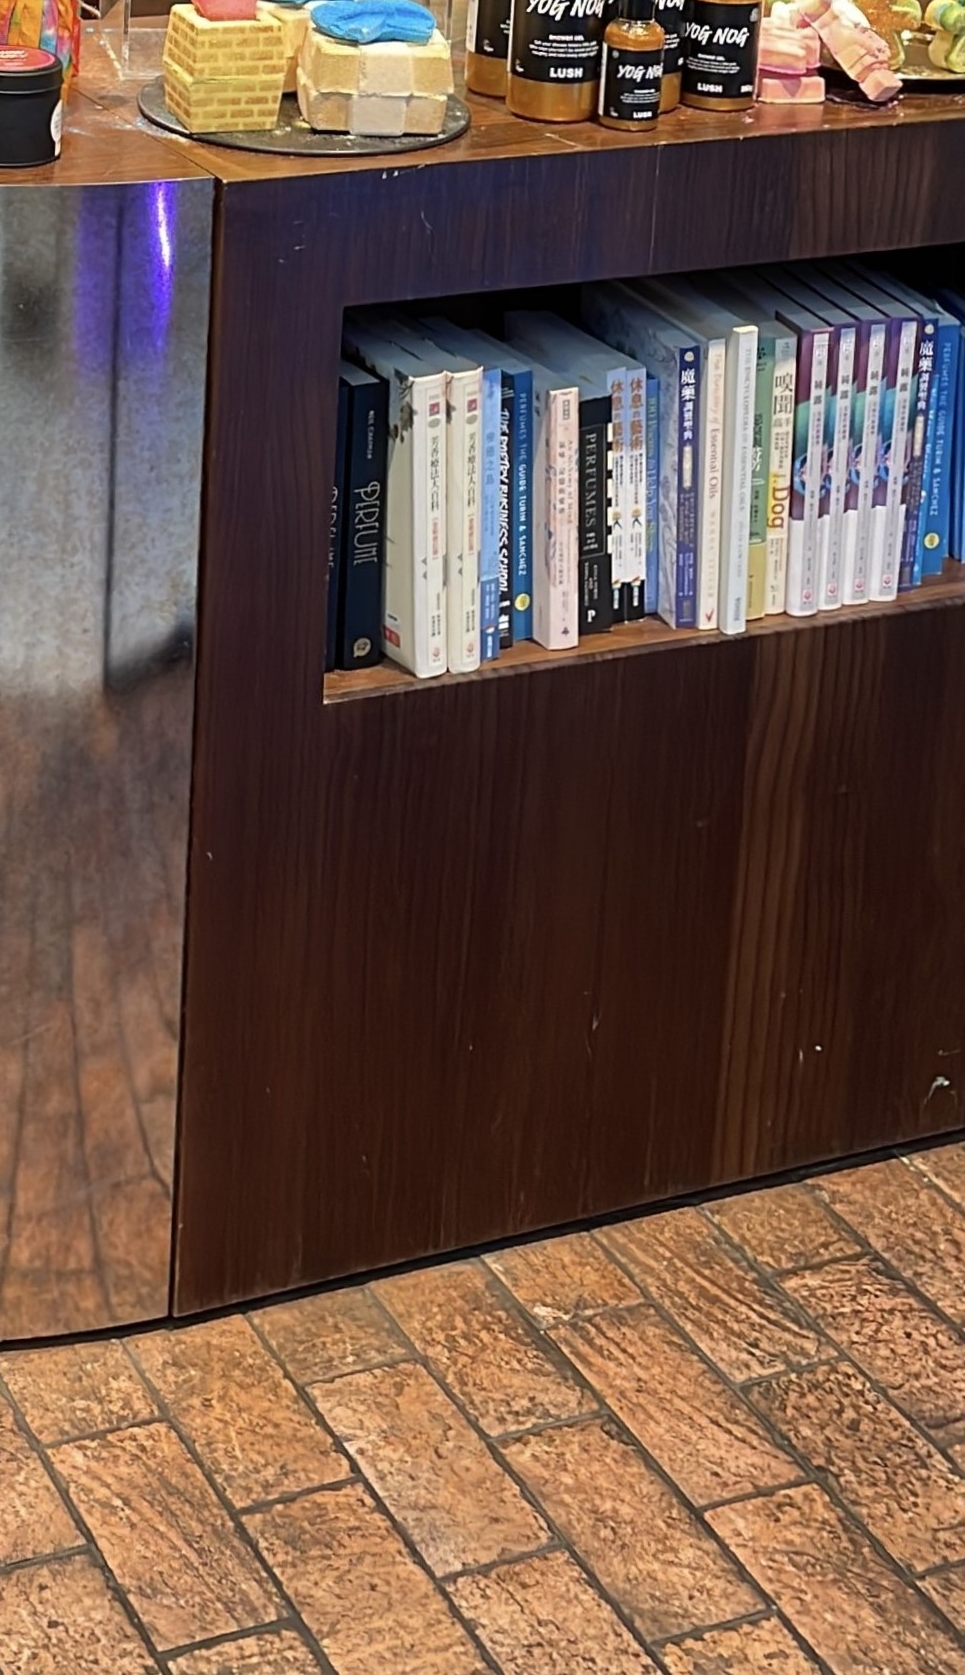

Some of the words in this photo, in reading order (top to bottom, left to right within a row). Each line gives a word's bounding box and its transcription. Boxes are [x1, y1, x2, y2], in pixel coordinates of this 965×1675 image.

[684, 21, 713, 46] YOG
[713, 26, 750, 48] NOG
[549, 67, 584, 79] LUSH
[616, 64, 646, 83] YOG
[697, 82, 724, 94] LUSH
[633, 110, 653, 119] LUSH
[939, 342, 952, 385] PERFUMES
[939, 390, 948, 407] THE
[518, 392, 527, 440] PERFUMES
[936, 409, 947, 436] GUIDE
[499, 435, 510, 484] POETRY
[519, 443, 527, 460] THE
[708, 428, 721, 474] Essential
[934, 439, 945, 465] TURIN
[518, 463, 527, 492] GUIDE
[584, 432, 598, 528] PERFUMES
[708, 475, 719, 500] Oils
[518, 494, 527, 522] TURIN
[766, 485, 790, 530] Dog
[929, 477, 941, 516] SANCHEZ
[352, 480, 381, 567] PERFUME
[498, 484, 510, 547] BUSINESS
[498, 547, 510, 592] SCHOOL
[517, 535, 527, 576] SANCHEZ
